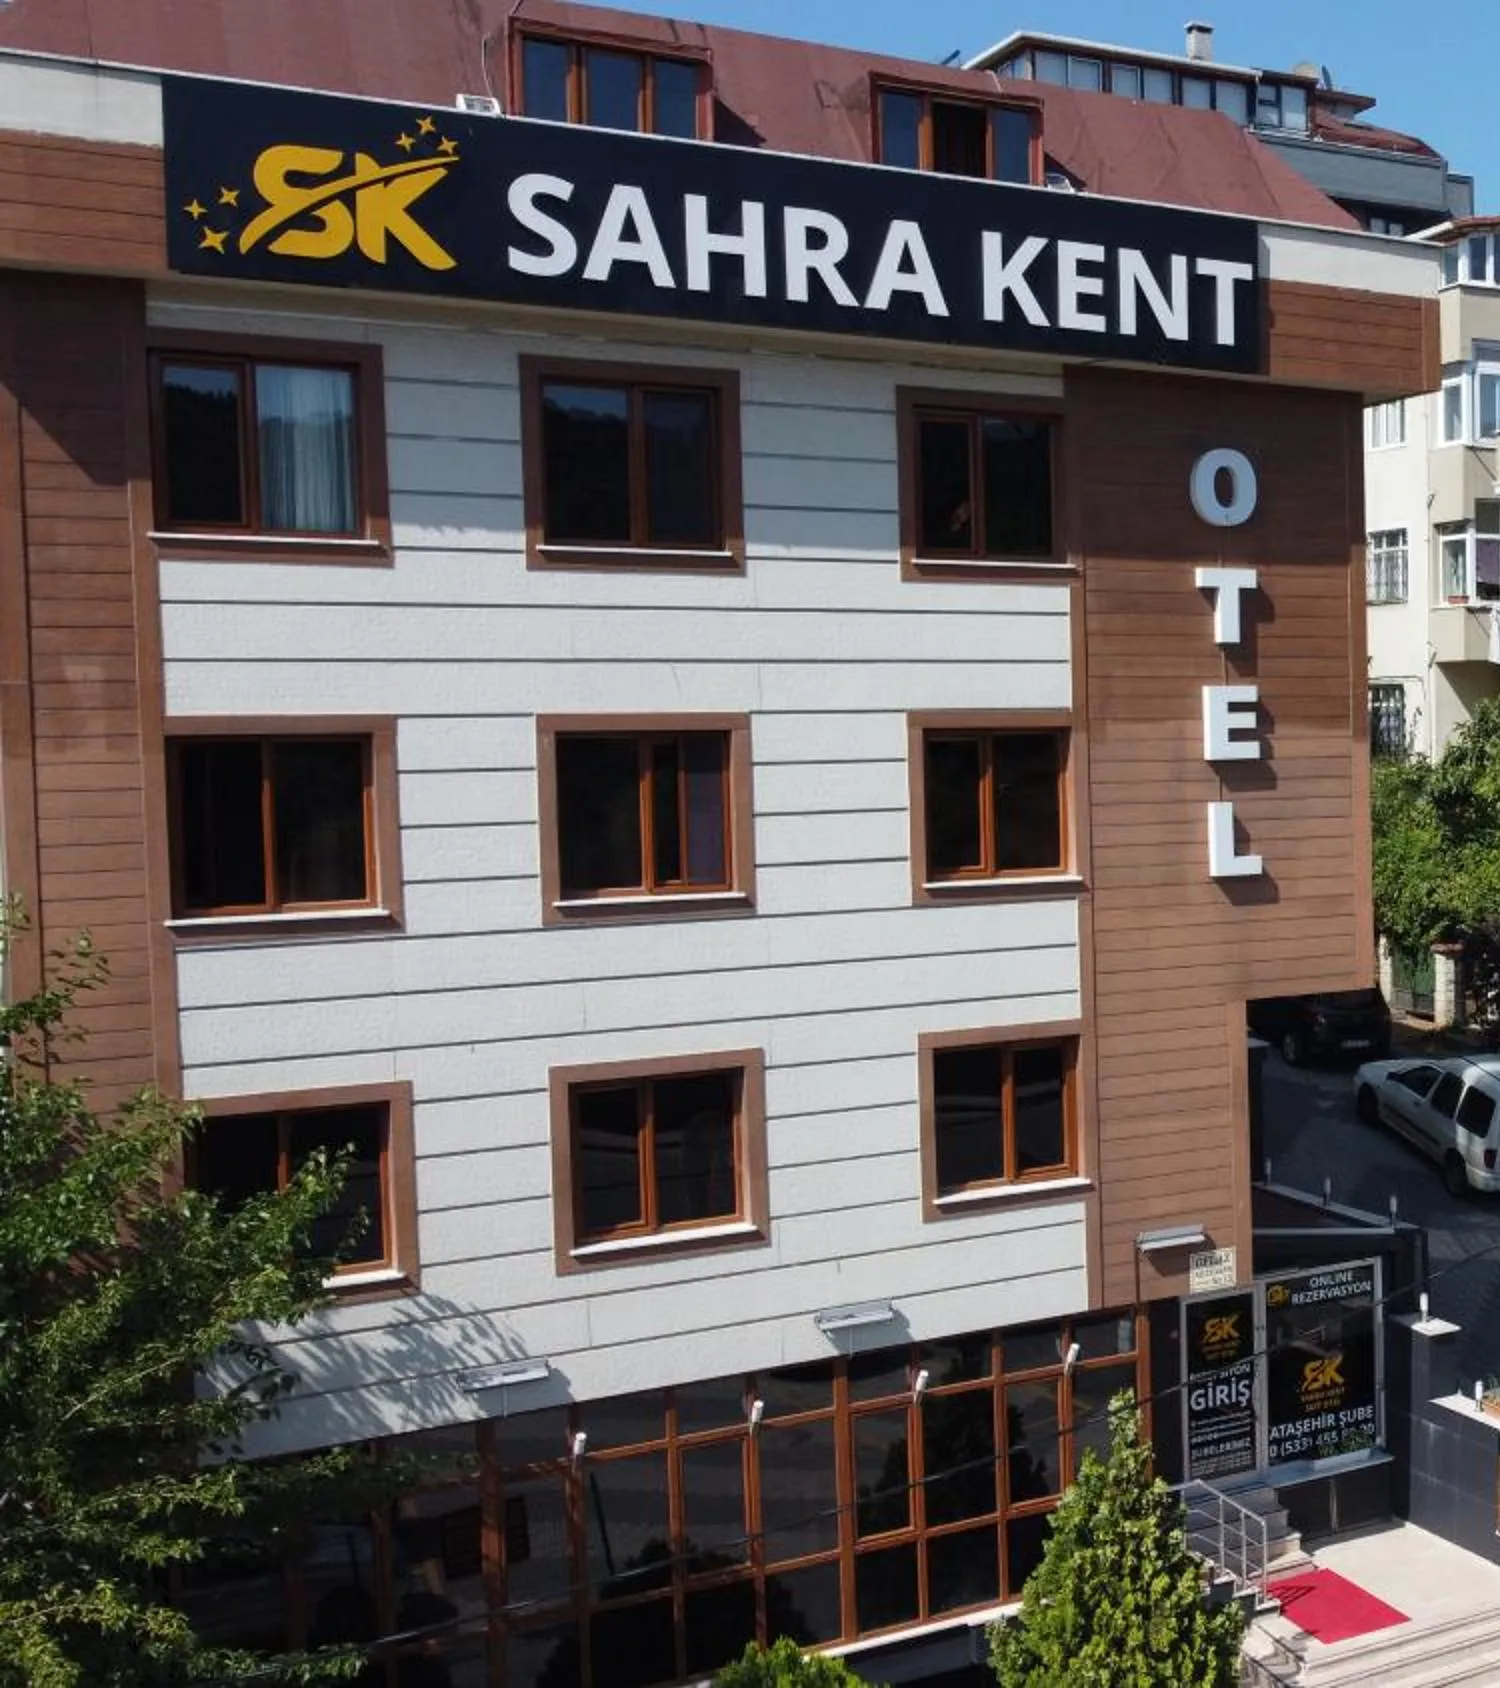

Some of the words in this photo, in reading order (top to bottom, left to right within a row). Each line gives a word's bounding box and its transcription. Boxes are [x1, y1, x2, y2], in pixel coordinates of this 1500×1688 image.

[239, 144, 460, 271] SK
[507, 172, 950, 318] SAHRA
[981, 229, 1253, 347] KENT
[1189, 447, 1263, 877] OTEL
[1291, 1280, 1371, 1305] REZERVASYON
[1203, 1314, 1240, 1343] SK
[1302, 1354, 1344, 1392] SK
[1190, 1377, 1250, 1410] GİRİŞ
